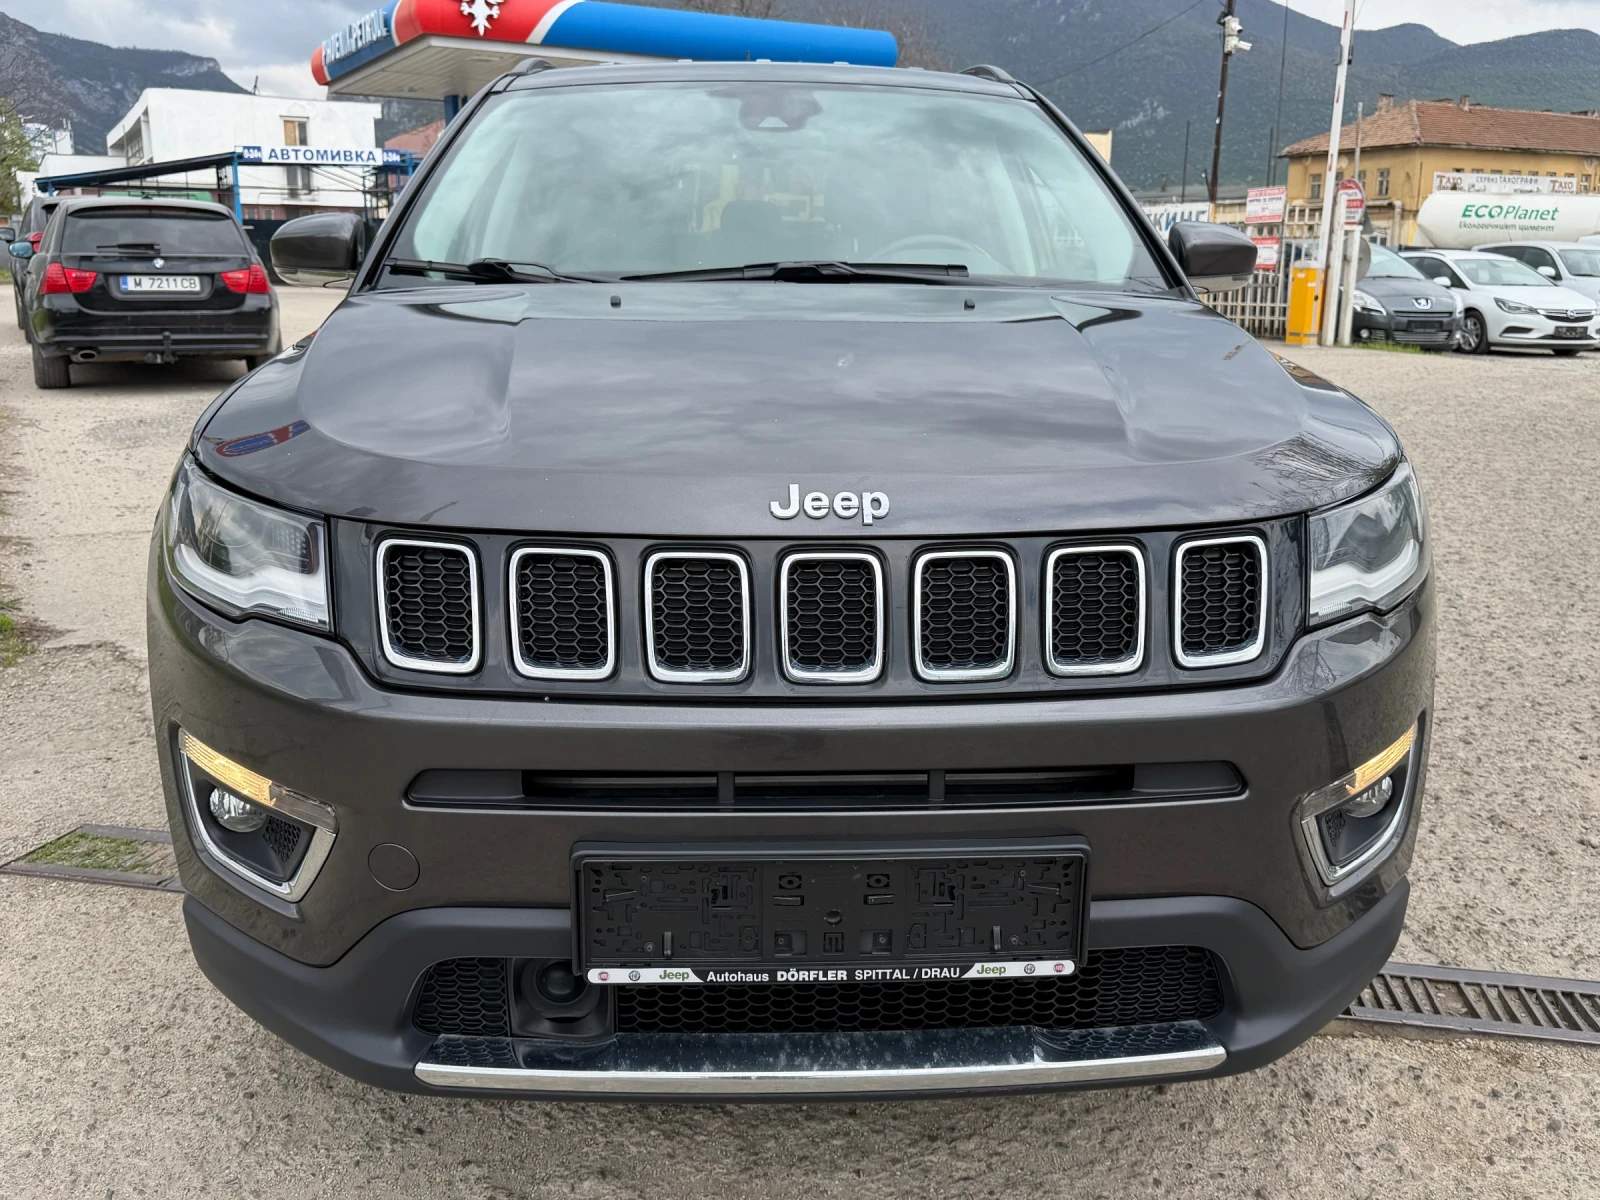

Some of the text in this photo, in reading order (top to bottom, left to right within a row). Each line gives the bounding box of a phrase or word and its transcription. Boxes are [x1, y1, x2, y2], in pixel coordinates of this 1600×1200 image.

[268, 148, 377, 163] АВТОМИВКА
[1461, 204, 1559, 221] ECOPlanet
[769, 483, 890, 526] Jeep
[658, 969, 690, 982] Jeep
[706, 971, 770, 982] Autohaus
[776, 967, 848, 982] DÖRFLER
[854, 967, 910, 980] SPITTAL
[921, 966, 961, 979] DRAU
[976, 964, 1007, 976] Jeep
